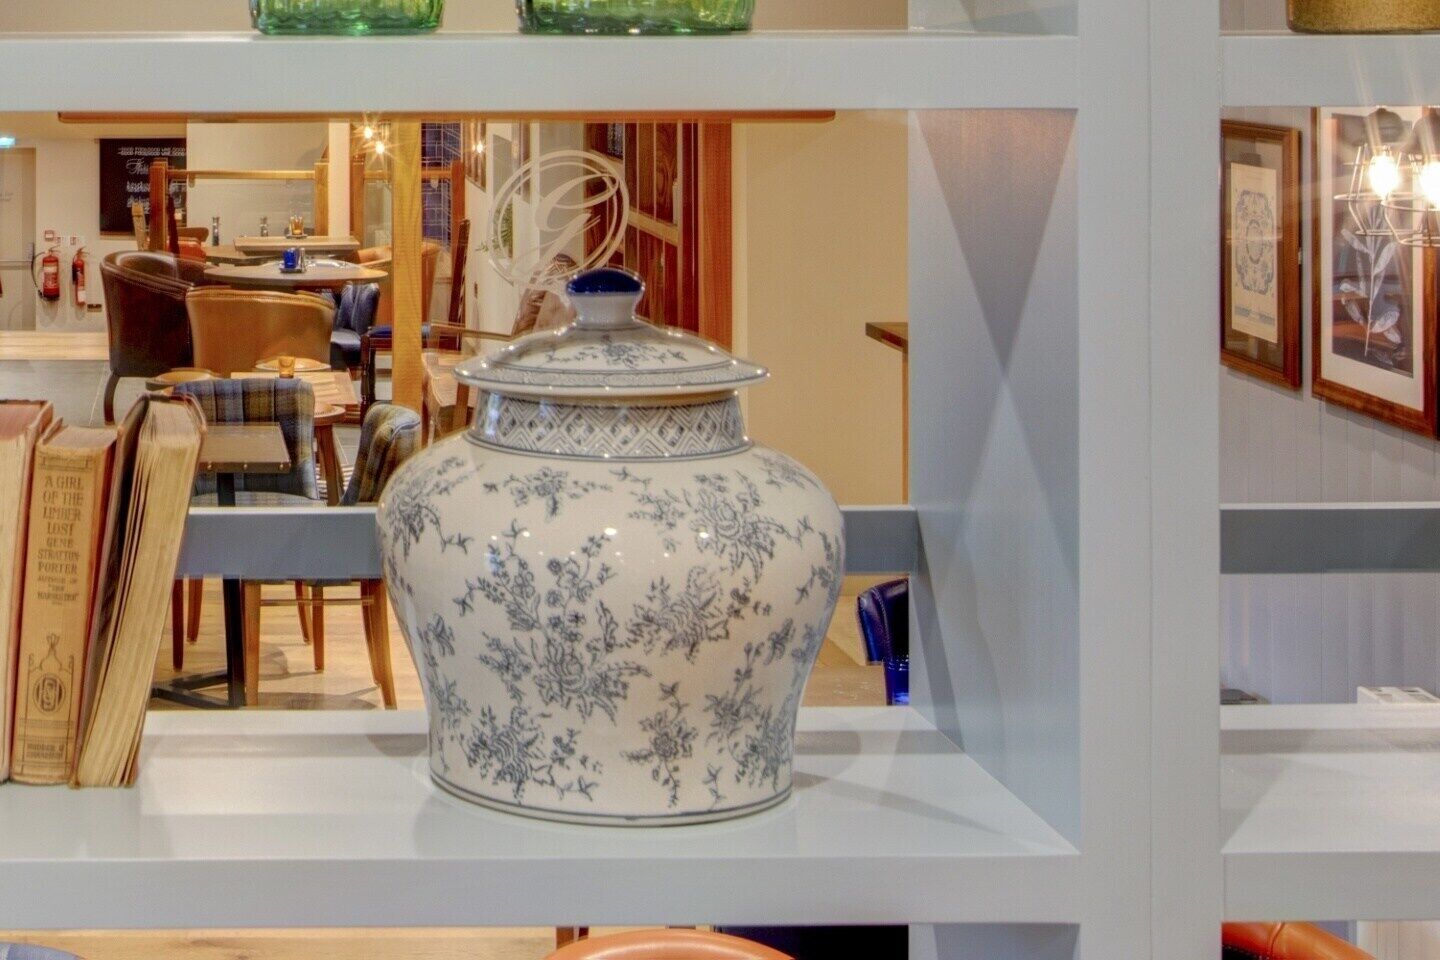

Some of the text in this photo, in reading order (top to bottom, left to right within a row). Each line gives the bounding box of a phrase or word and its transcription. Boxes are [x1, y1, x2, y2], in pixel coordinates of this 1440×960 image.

[56, 476, 84, 490] GIRL
[43, 490, 83, 506] OF THE
[43, 506, 81, 521] LIMBER
[47, 521, 74, 536] LOST
[46, 537, 74, 548] GENE
[38, 561, 79, 575] PORTER
